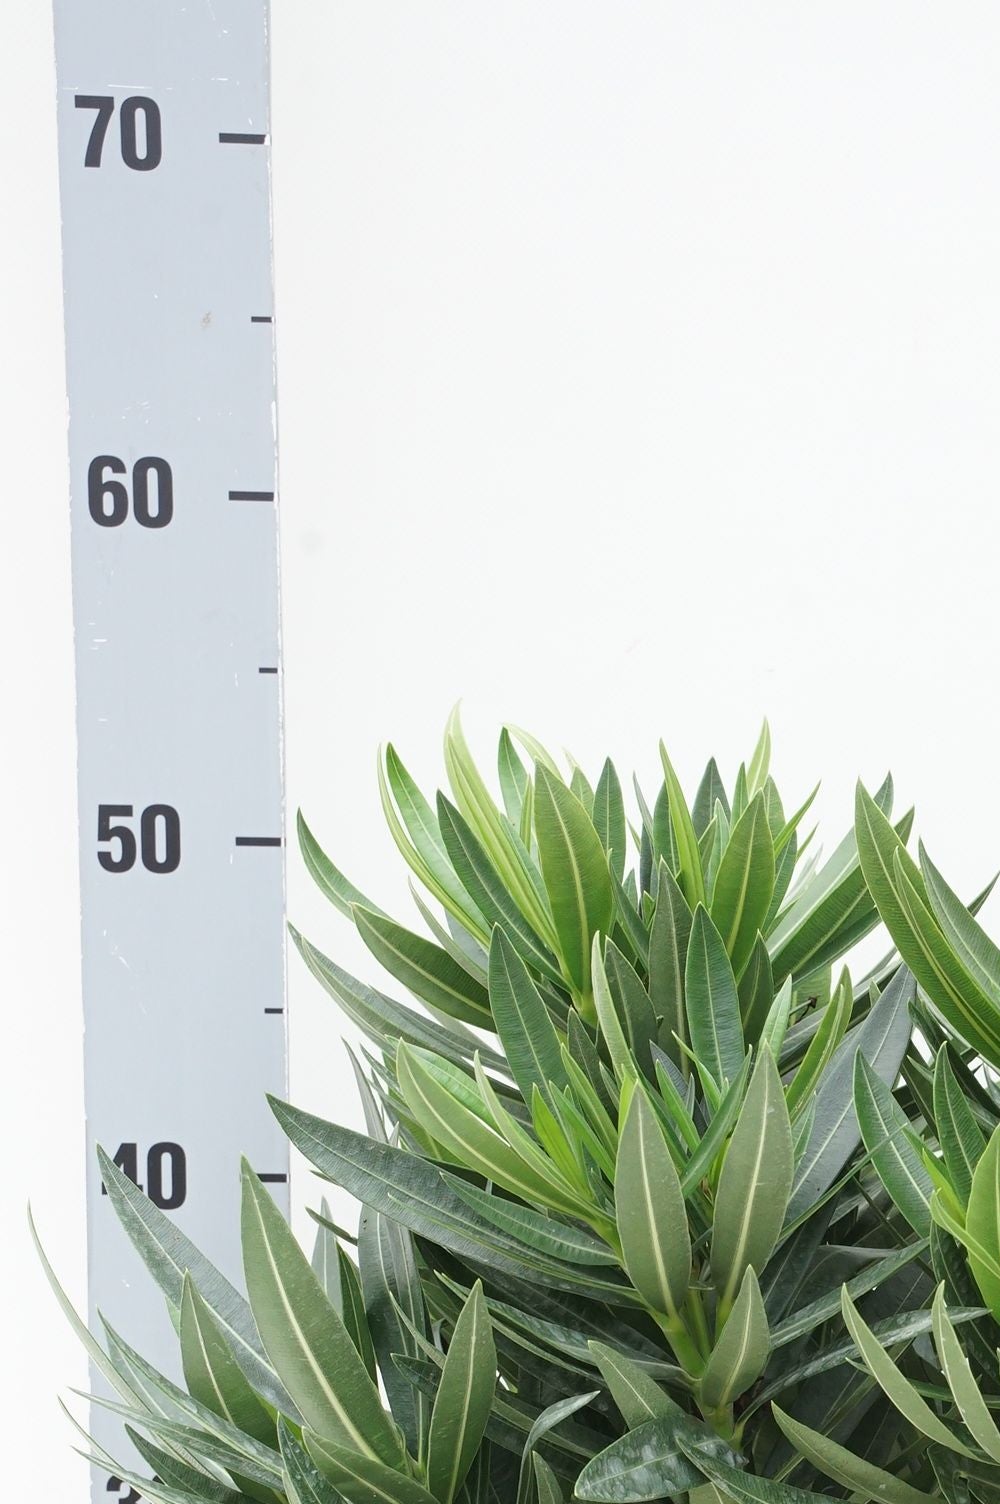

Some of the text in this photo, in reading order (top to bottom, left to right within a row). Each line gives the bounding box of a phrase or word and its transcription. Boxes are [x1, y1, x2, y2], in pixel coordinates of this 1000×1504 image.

[75, 95, 162, 171] 70
[88, 456, 174, 529] 60
[97, 804, 181, 874] 50
